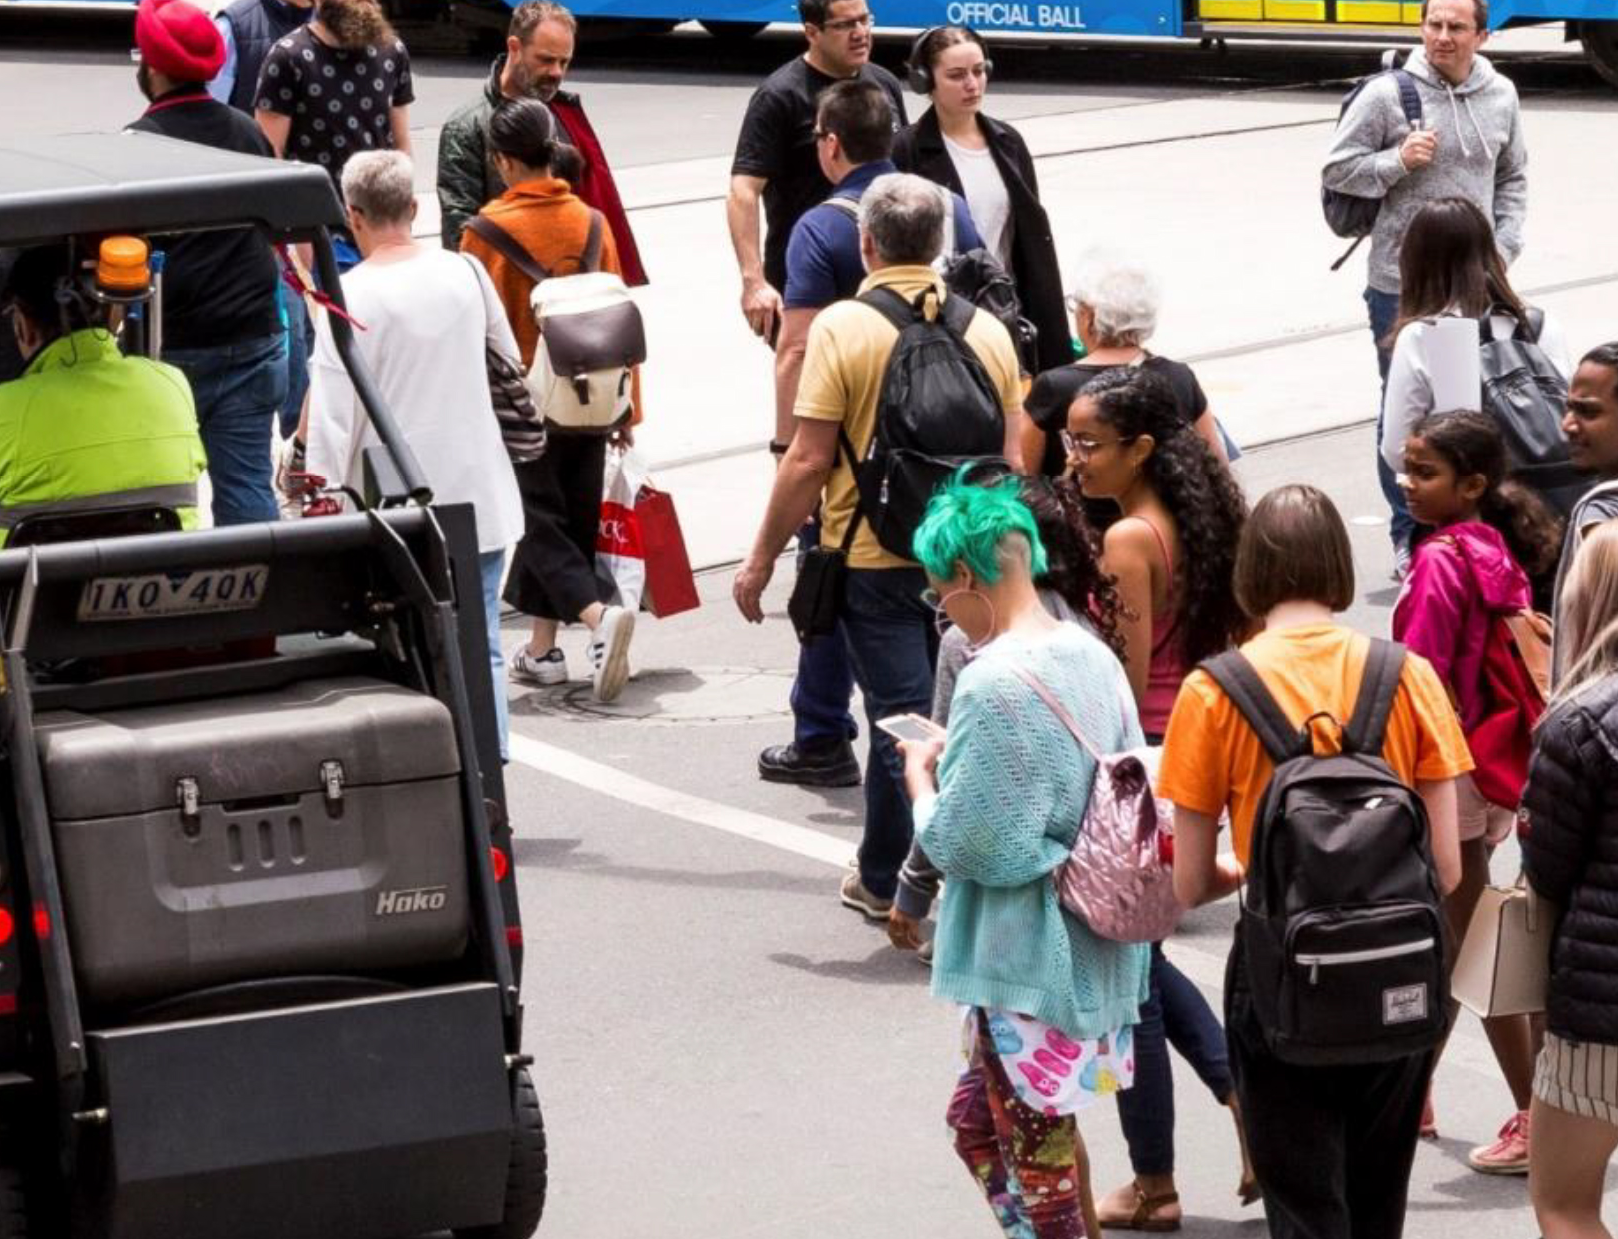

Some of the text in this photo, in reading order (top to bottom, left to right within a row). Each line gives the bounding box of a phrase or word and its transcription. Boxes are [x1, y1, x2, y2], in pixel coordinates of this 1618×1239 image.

[946, 1, 1086, 29] OFFICIAL BALL
[375, 884, 448, 916] Hako
